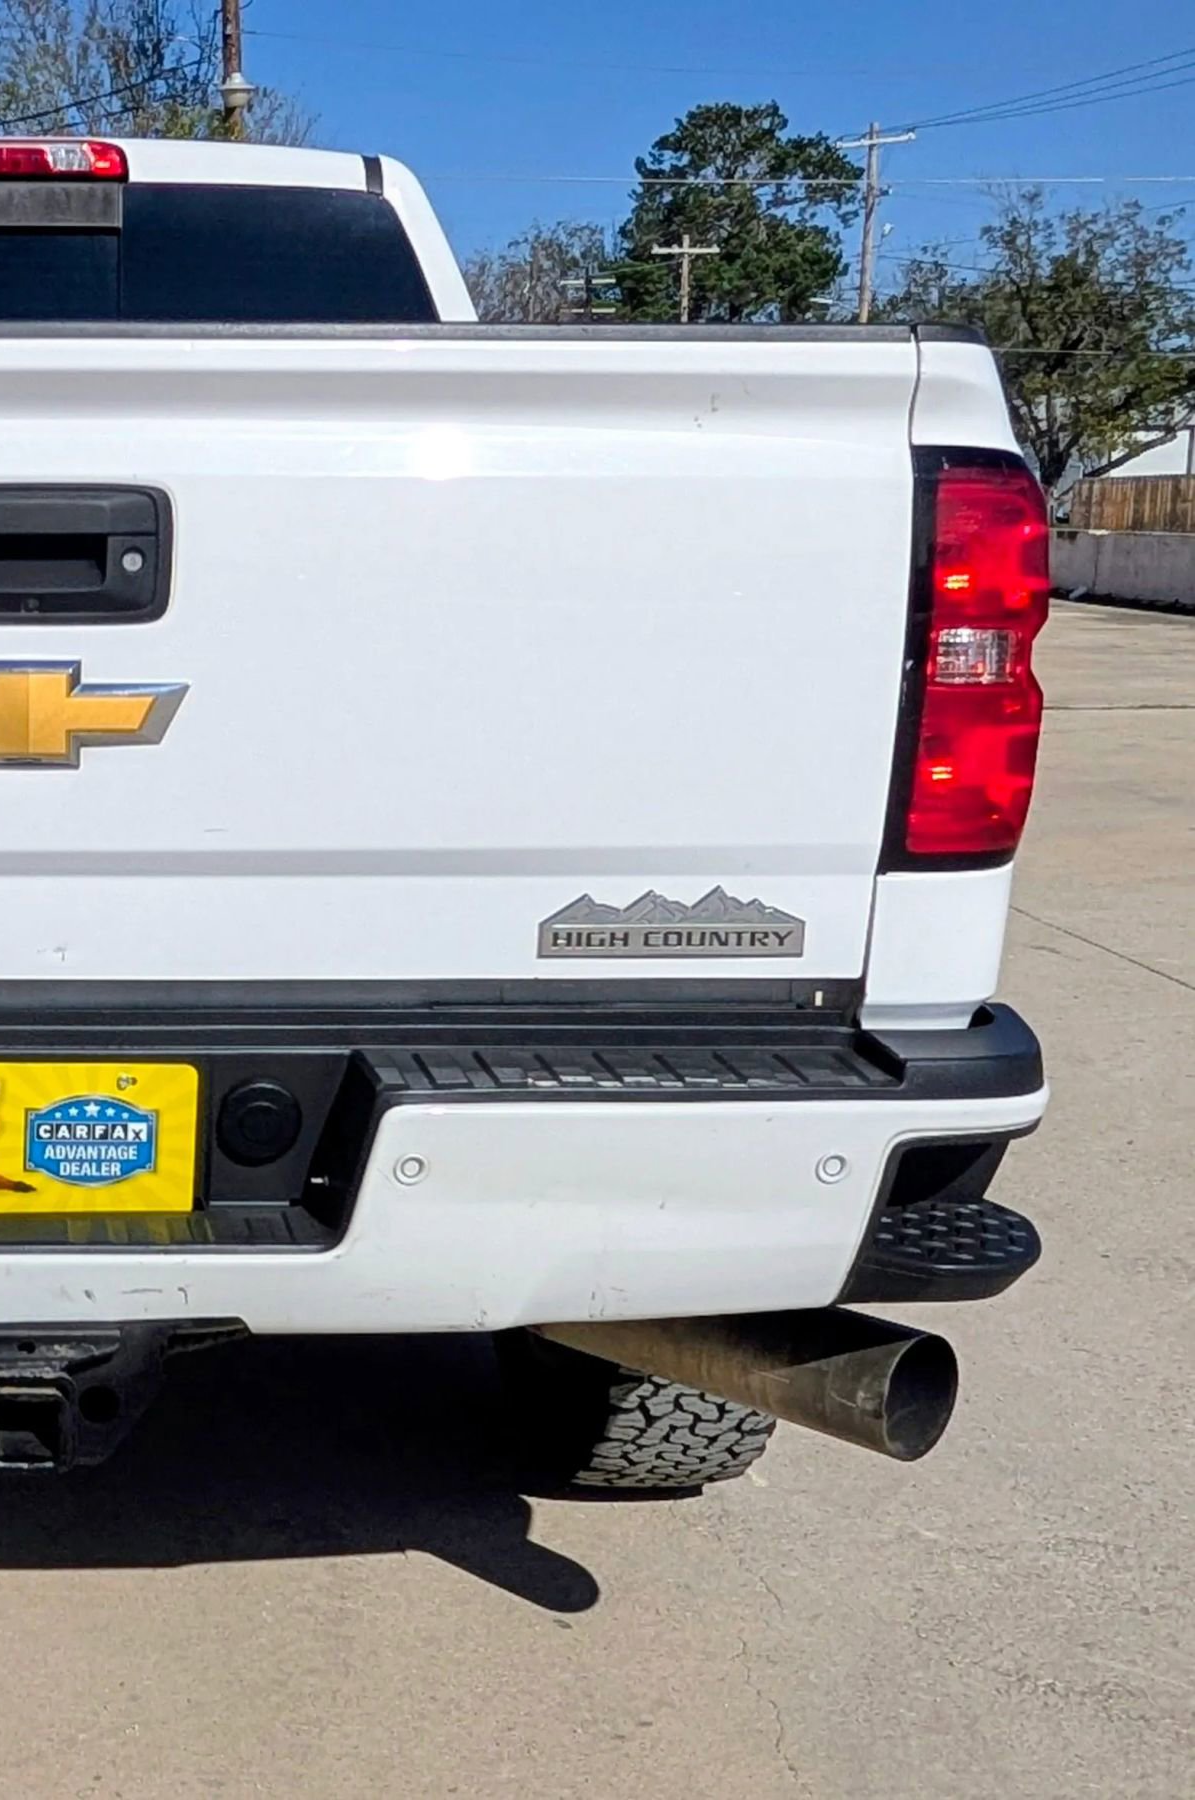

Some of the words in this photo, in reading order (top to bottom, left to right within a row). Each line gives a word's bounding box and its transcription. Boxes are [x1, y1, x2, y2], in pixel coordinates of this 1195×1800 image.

[551, 931, 629, 948] HIGH
[643, 930, 794, 947] COUNTRY
[38, 1124, 145, 1142] CARFAX
[43, 1144, 138, 1160] ADVANTAGE
[59, 1161, 122, 1176] DEALER
